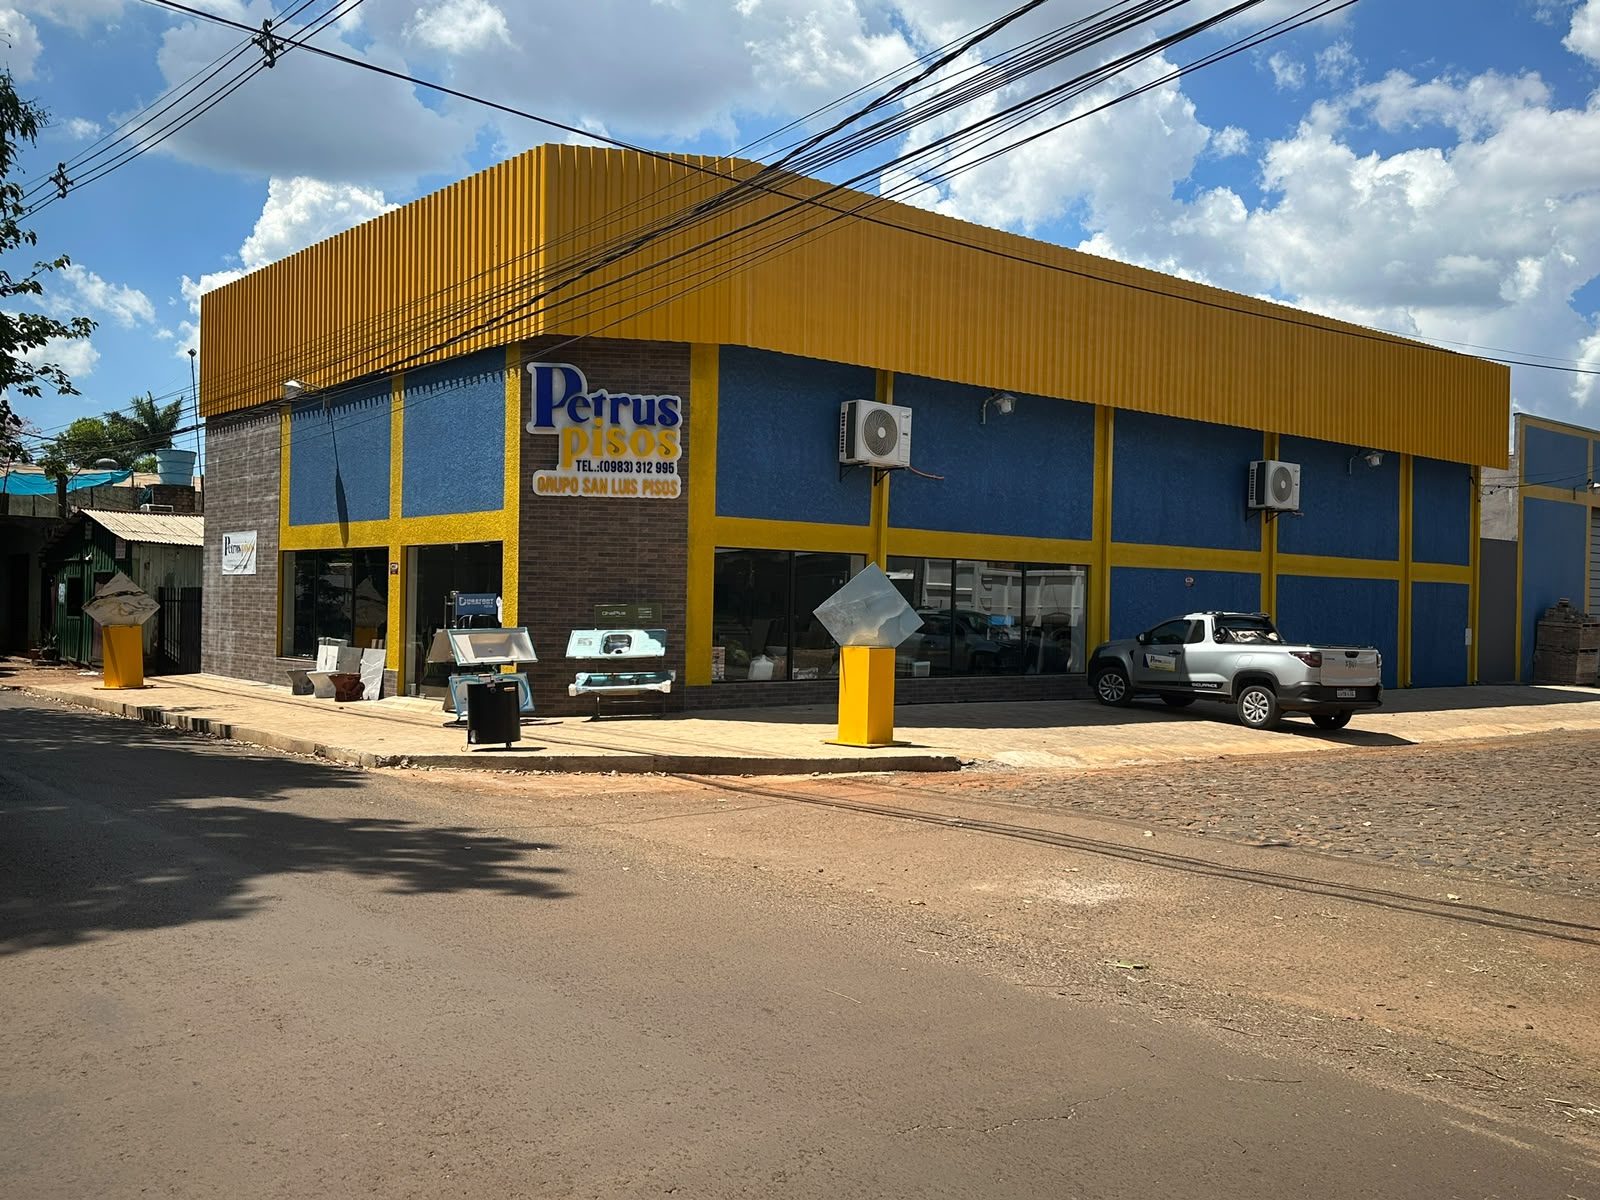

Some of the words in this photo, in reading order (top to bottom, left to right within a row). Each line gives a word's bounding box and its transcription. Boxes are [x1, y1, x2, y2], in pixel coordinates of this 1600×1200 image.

[533, 366, 679, 428] Petrus
[561, 417, 679, 470] pisos
[537, 475, 579, 494] GRUPO
[582, 477, 609, 495] SAN
[611, 478, 638, 495] LUIS
[642, 479, 678, 496] PISOS
[635, 461, 653, 474] 312
[655, 462, 675, 474] 995
